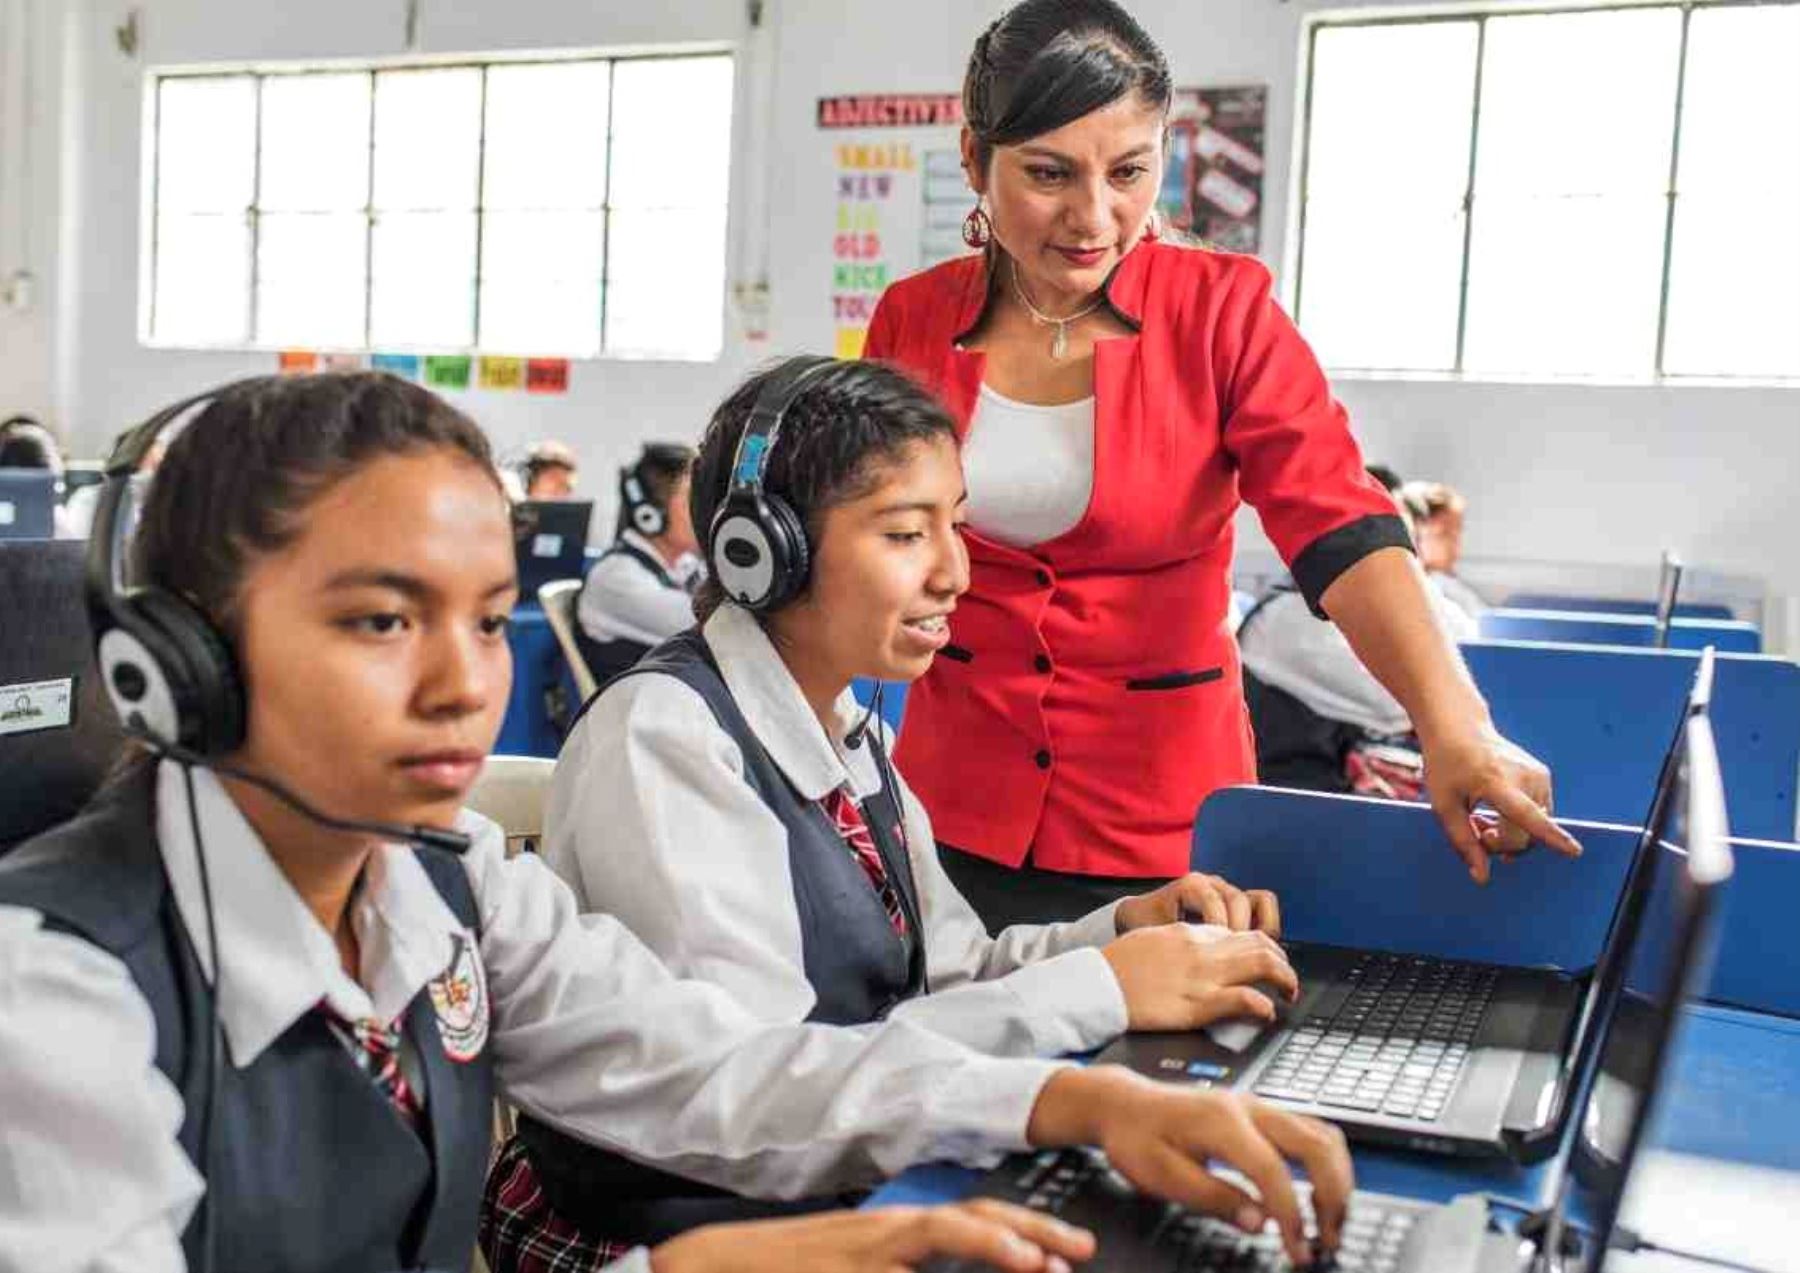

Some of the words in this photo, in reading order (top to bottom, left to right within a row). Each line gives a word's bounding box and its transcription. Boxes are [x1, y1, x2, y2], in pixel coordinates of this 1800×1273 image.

[835, 143, 916, 171] SMALL
[837, 175, 892, 199] NEW
[834, 232, 880, 261] OLD
